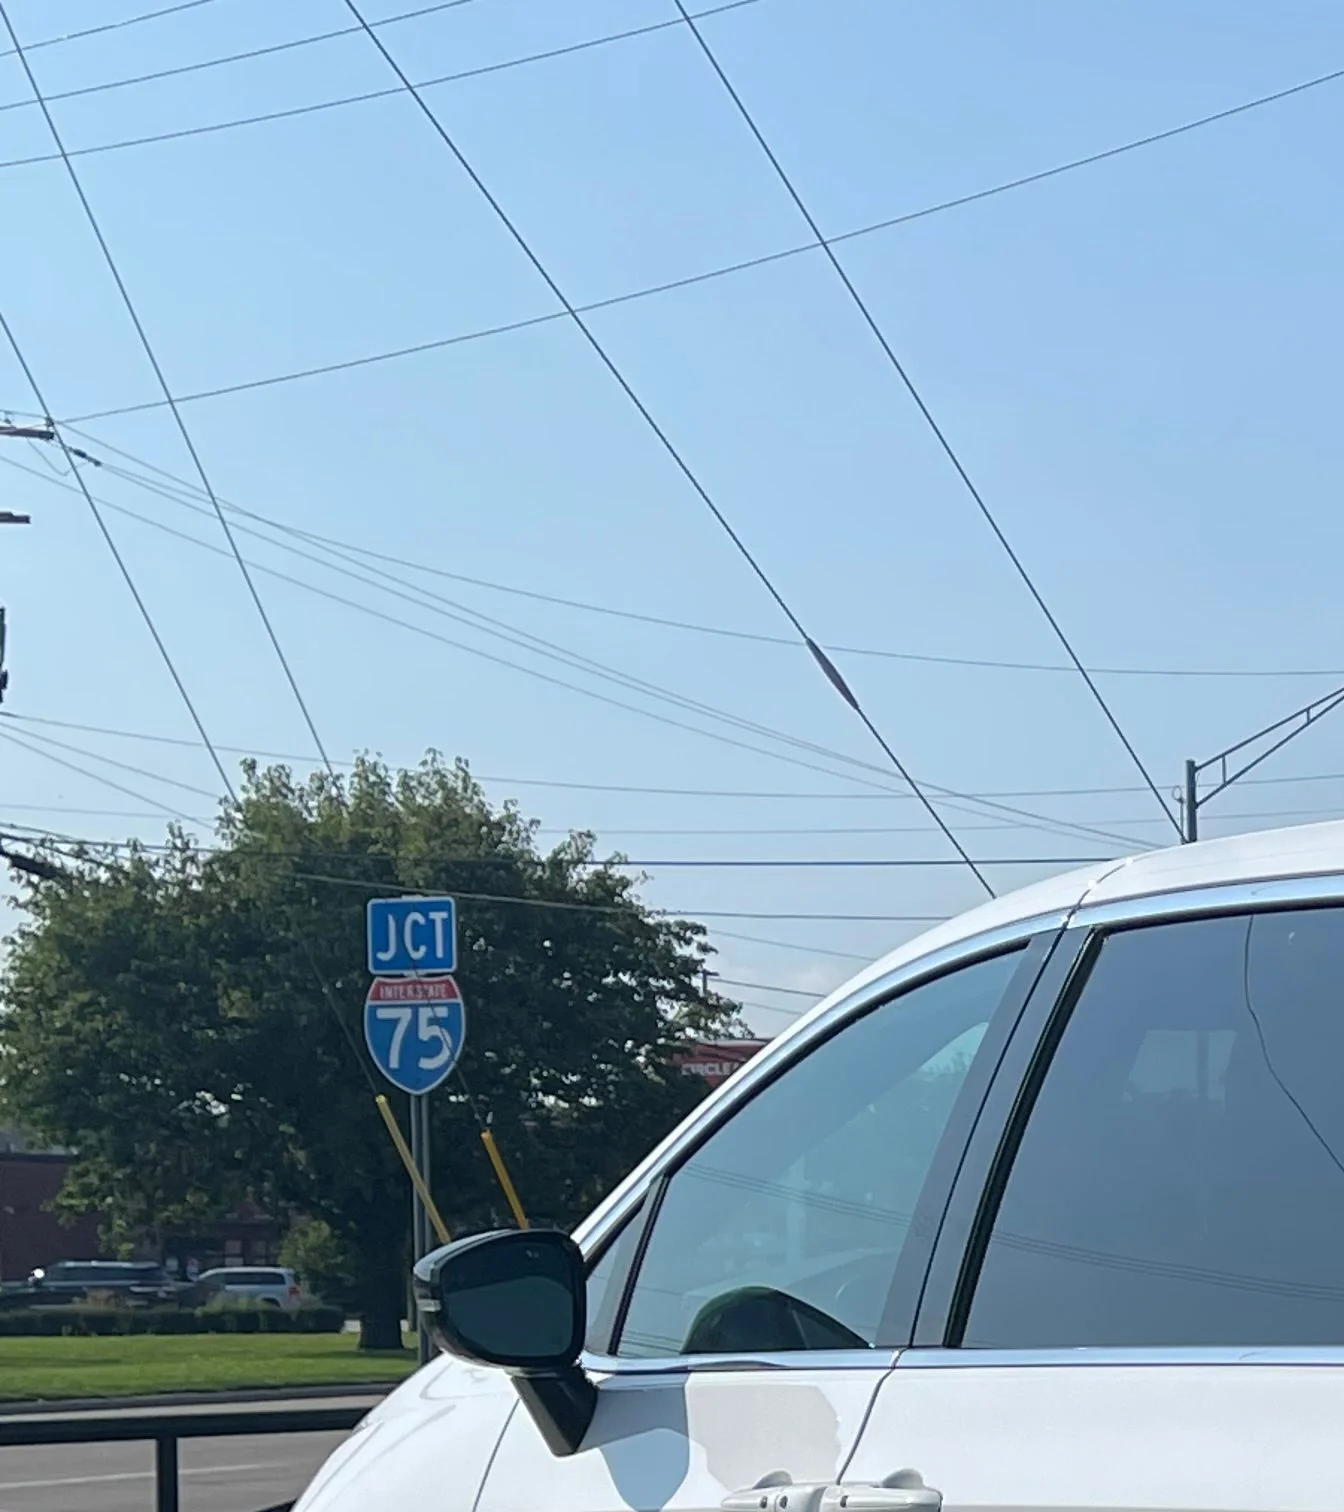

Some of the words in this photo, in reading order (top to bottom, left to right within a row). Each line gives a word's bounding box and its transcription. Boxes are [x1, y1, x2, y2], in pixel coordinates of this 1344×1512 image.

[376, 911, 449, 961] JCT
[379, 983, 448, 1000] INTERSTATE
[376, 1006, 452, 1070] 75
